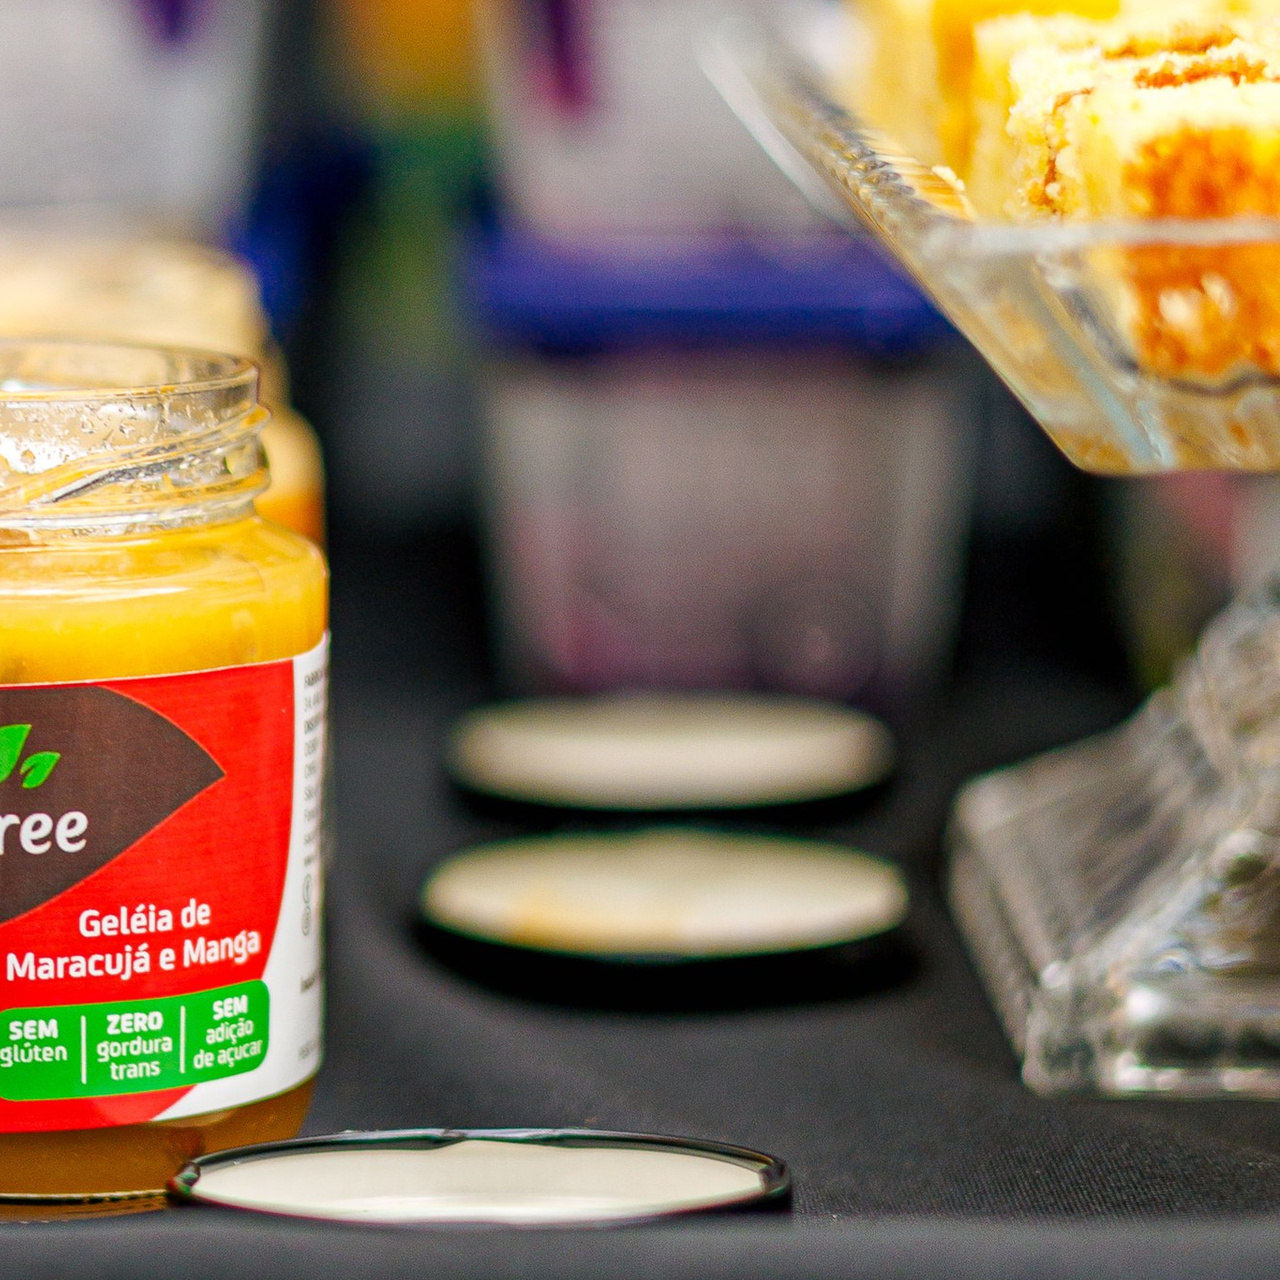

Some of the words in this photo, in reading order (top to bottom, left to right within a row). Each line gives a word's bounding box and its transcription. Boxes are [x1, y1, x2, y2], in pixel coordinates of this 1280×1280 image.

[78, 903, 173, 938] Geléia
[180, 898, 211, 929] de
[6, 942, 150, 981] Maracujá
[159, 946, 175, 970] e
[182, 930, 261, 967] Manga
[212, 994, 248, 1020] SEM
[8, 1018, 58, 1041] SEM
[106, 1011, 163, 1035] ZERO
[205, 1017, 254, 1045] adição
[0, 1042, 68, 1068] glúten
[96, 1035, 173, 1062] gordura
[193, 1048, 214, 1069] de
[110, 1060, 160, 1081] trans
